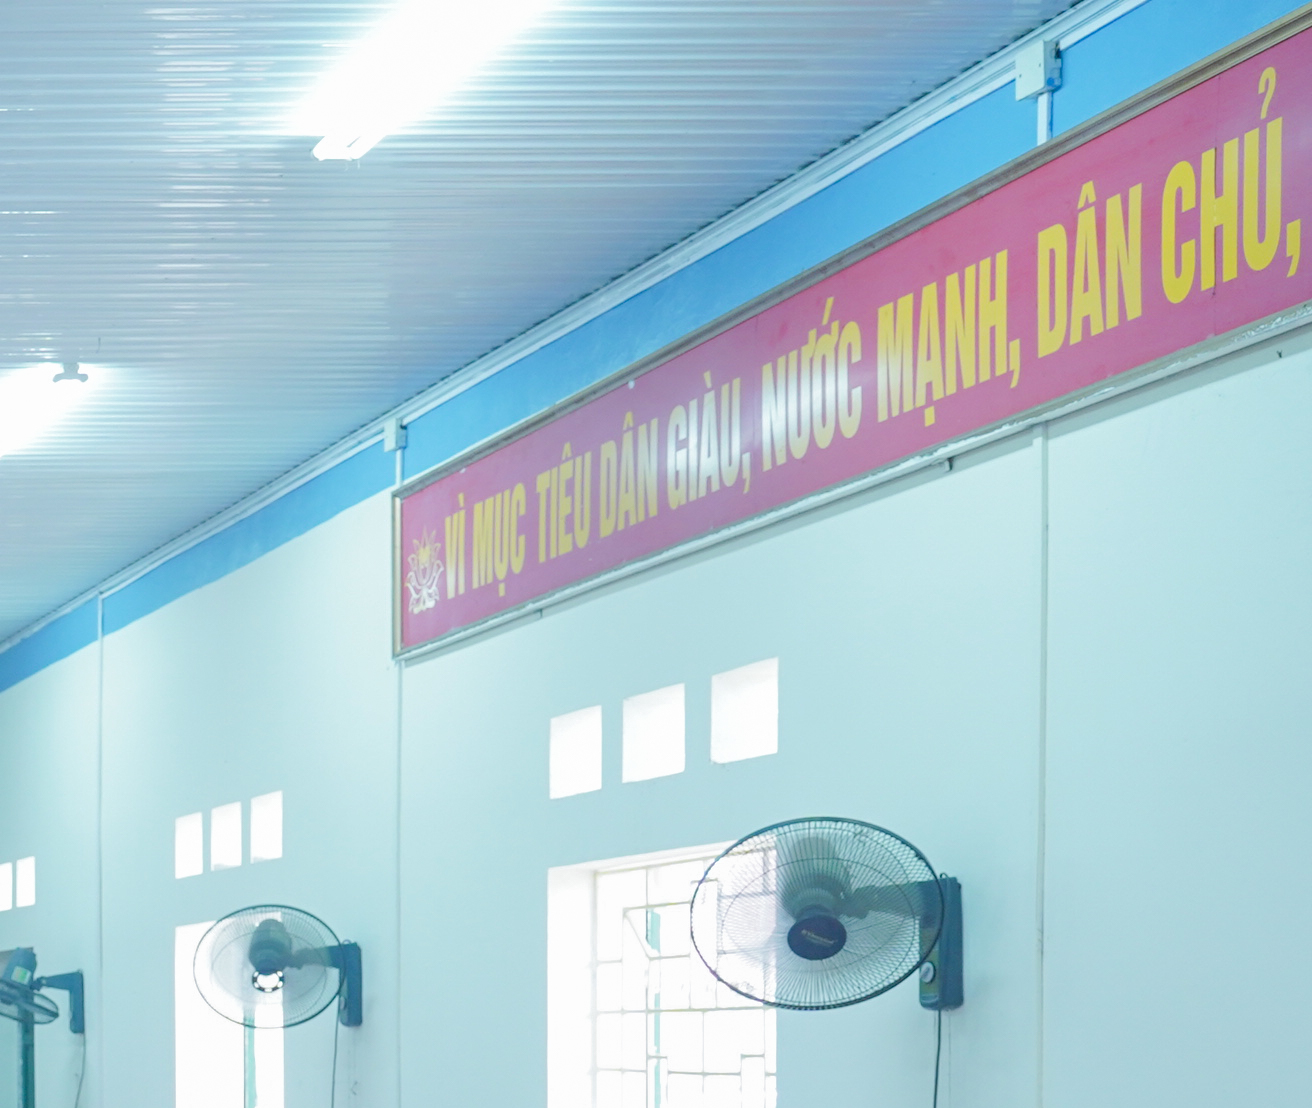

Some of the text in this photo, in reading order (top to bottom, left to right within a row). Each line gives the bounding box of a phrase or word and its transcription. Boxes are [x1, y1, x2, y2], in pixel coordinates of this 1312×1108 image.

[445, 66, 1301, 600] VÌ MỤC TIÊU DÂN GIÀU, NƯỚC MẠNH, DÂN CHỦ,
